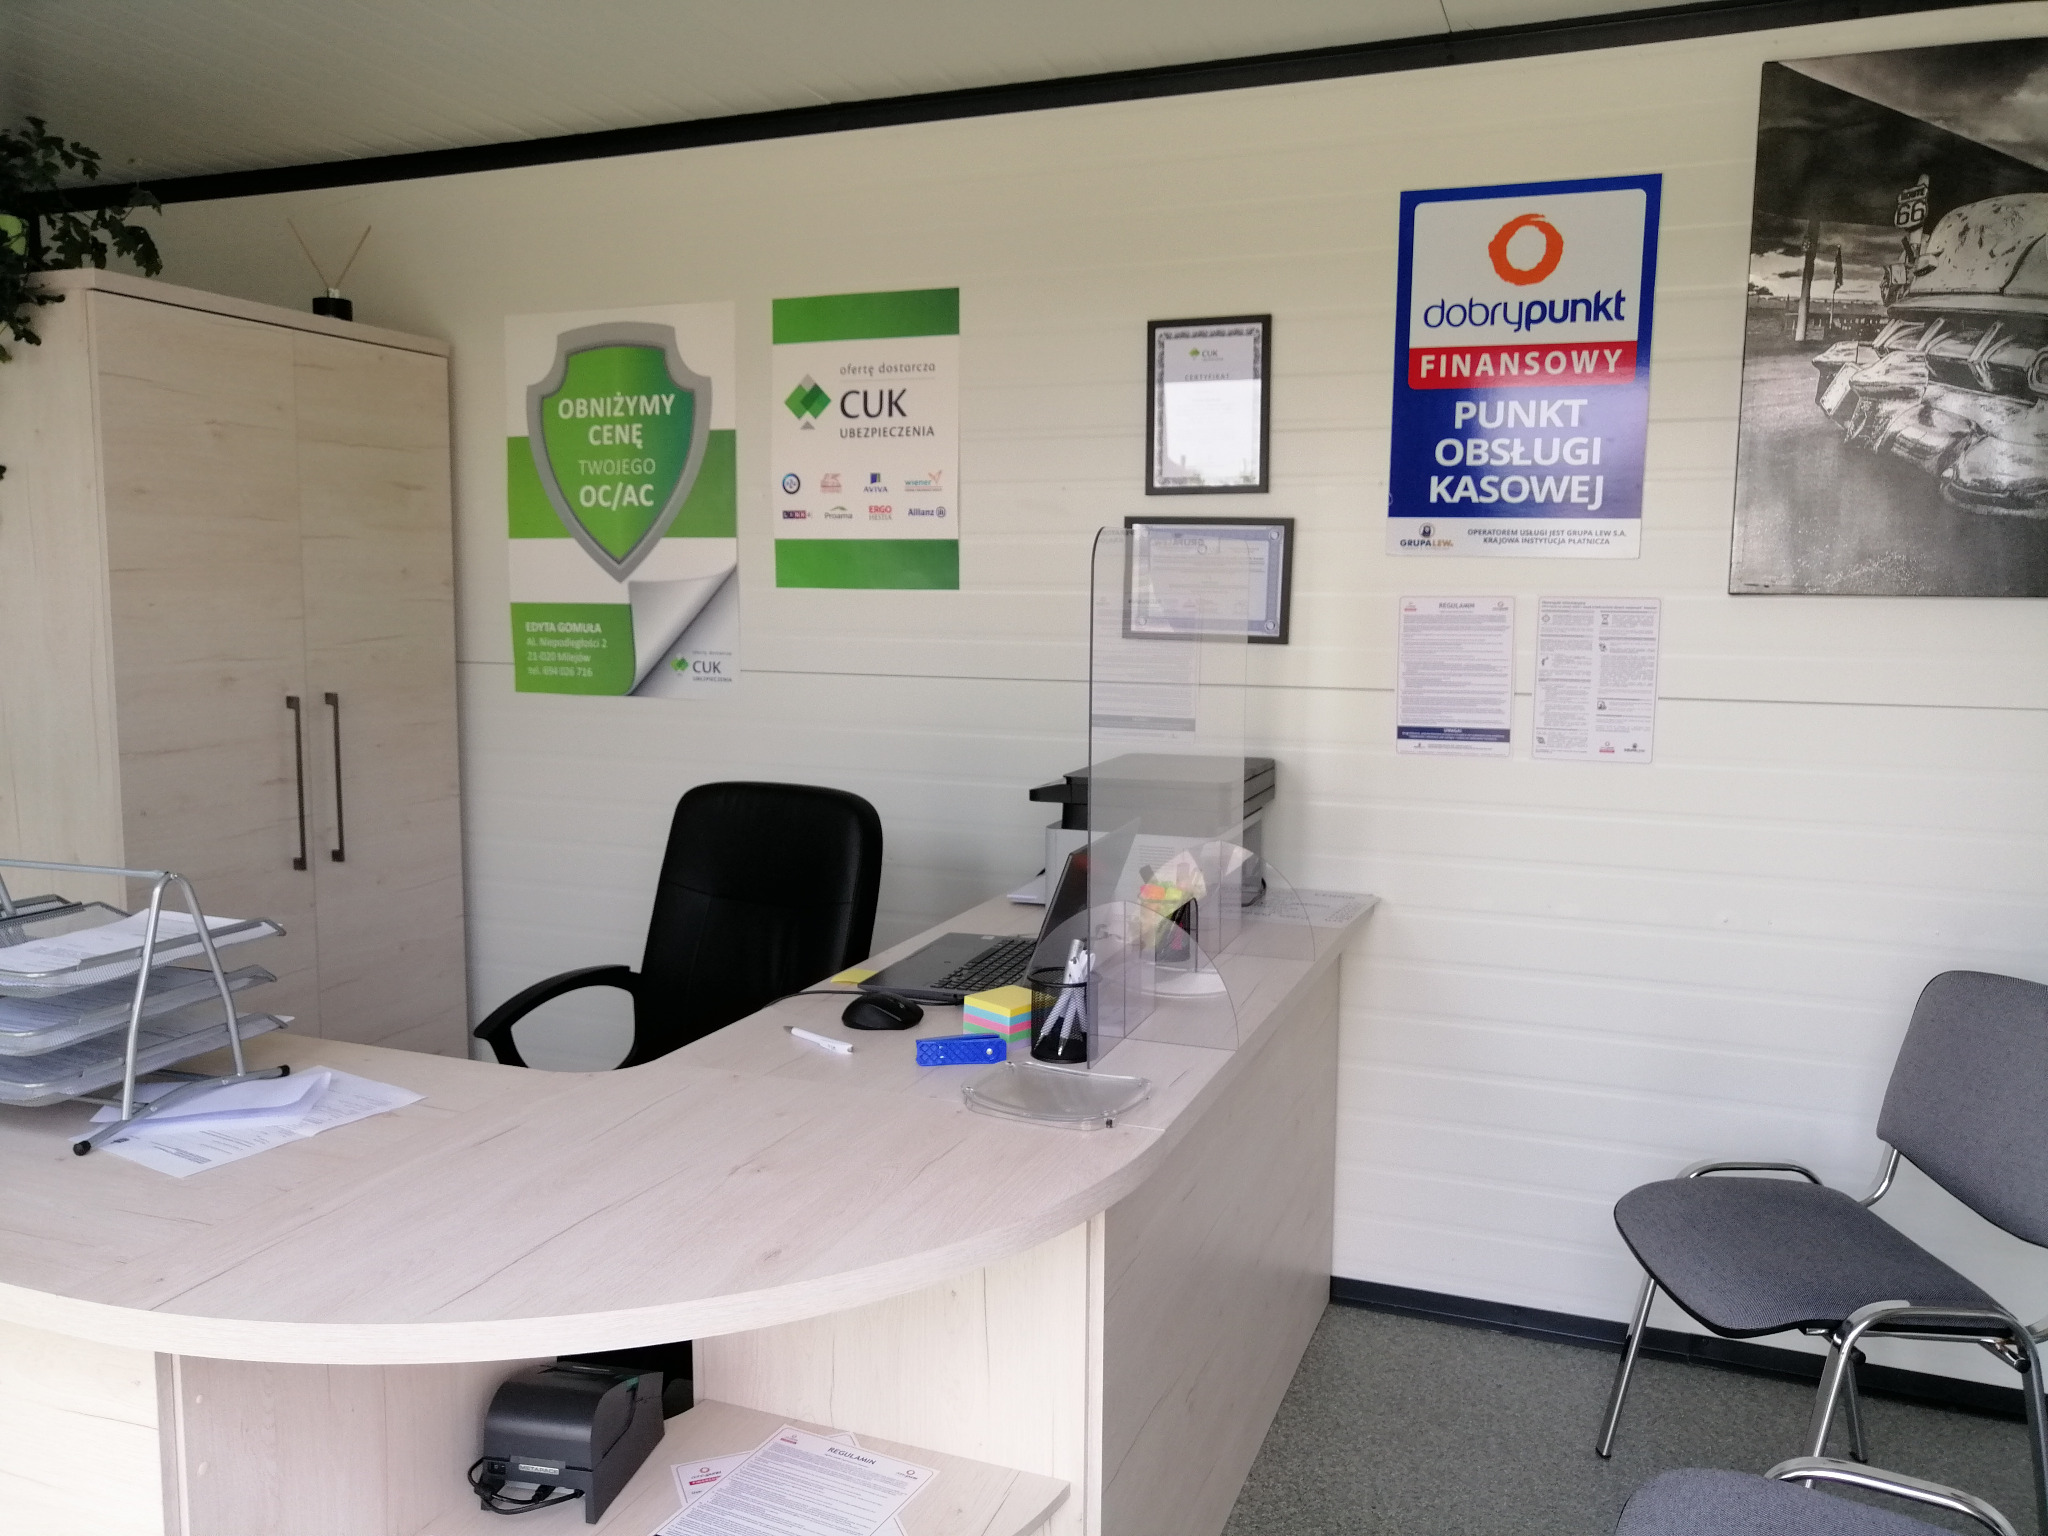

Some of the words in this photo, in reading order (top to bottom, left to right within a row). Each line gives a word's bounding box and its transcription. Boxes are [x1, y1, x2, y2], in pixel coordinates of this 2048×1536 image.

[1896, 200, 1925, 225] 66
[1423, 290, 1626, 332] dobrypunkt
[839, 362, 875, 377] ofertę
[878, 362, 936, 374] dostarcza
[1420, 348, 1623, 378] FINANSOWY
[558, 391, 676, 419] OBNIŻYMY
[839, 388, 907, 419] CUK
[1454, 399, 1588, 429] PUNKT
[588, 423, 643, 449] CENĘ
[839, 425, 935, 439] UBEZPIECZENIA
[1434, 437, 1601, 467] OBSŁUGI
[578, 458, 656, 476] TWOJEGO
[579, 482, 655, 512] OC/AC
[1429, 475, 1604, 511] KASOWEJ
[868, 505, 892, 513] ERGO
[907, 508, 935, 516] Allianz
[1483, 537, 1520, 545] KRAJOWA
[1520, 529, 1547, 537] USŁUGI
[1549, 530, 1565, 538] JEST
[1613, 530, 1627, 538] S.A.
[525, 621, 556, 633] EDYTA
[692, 660, 722, 674] CUK
[827, 1446, 877, 1466] REGULAMIN
